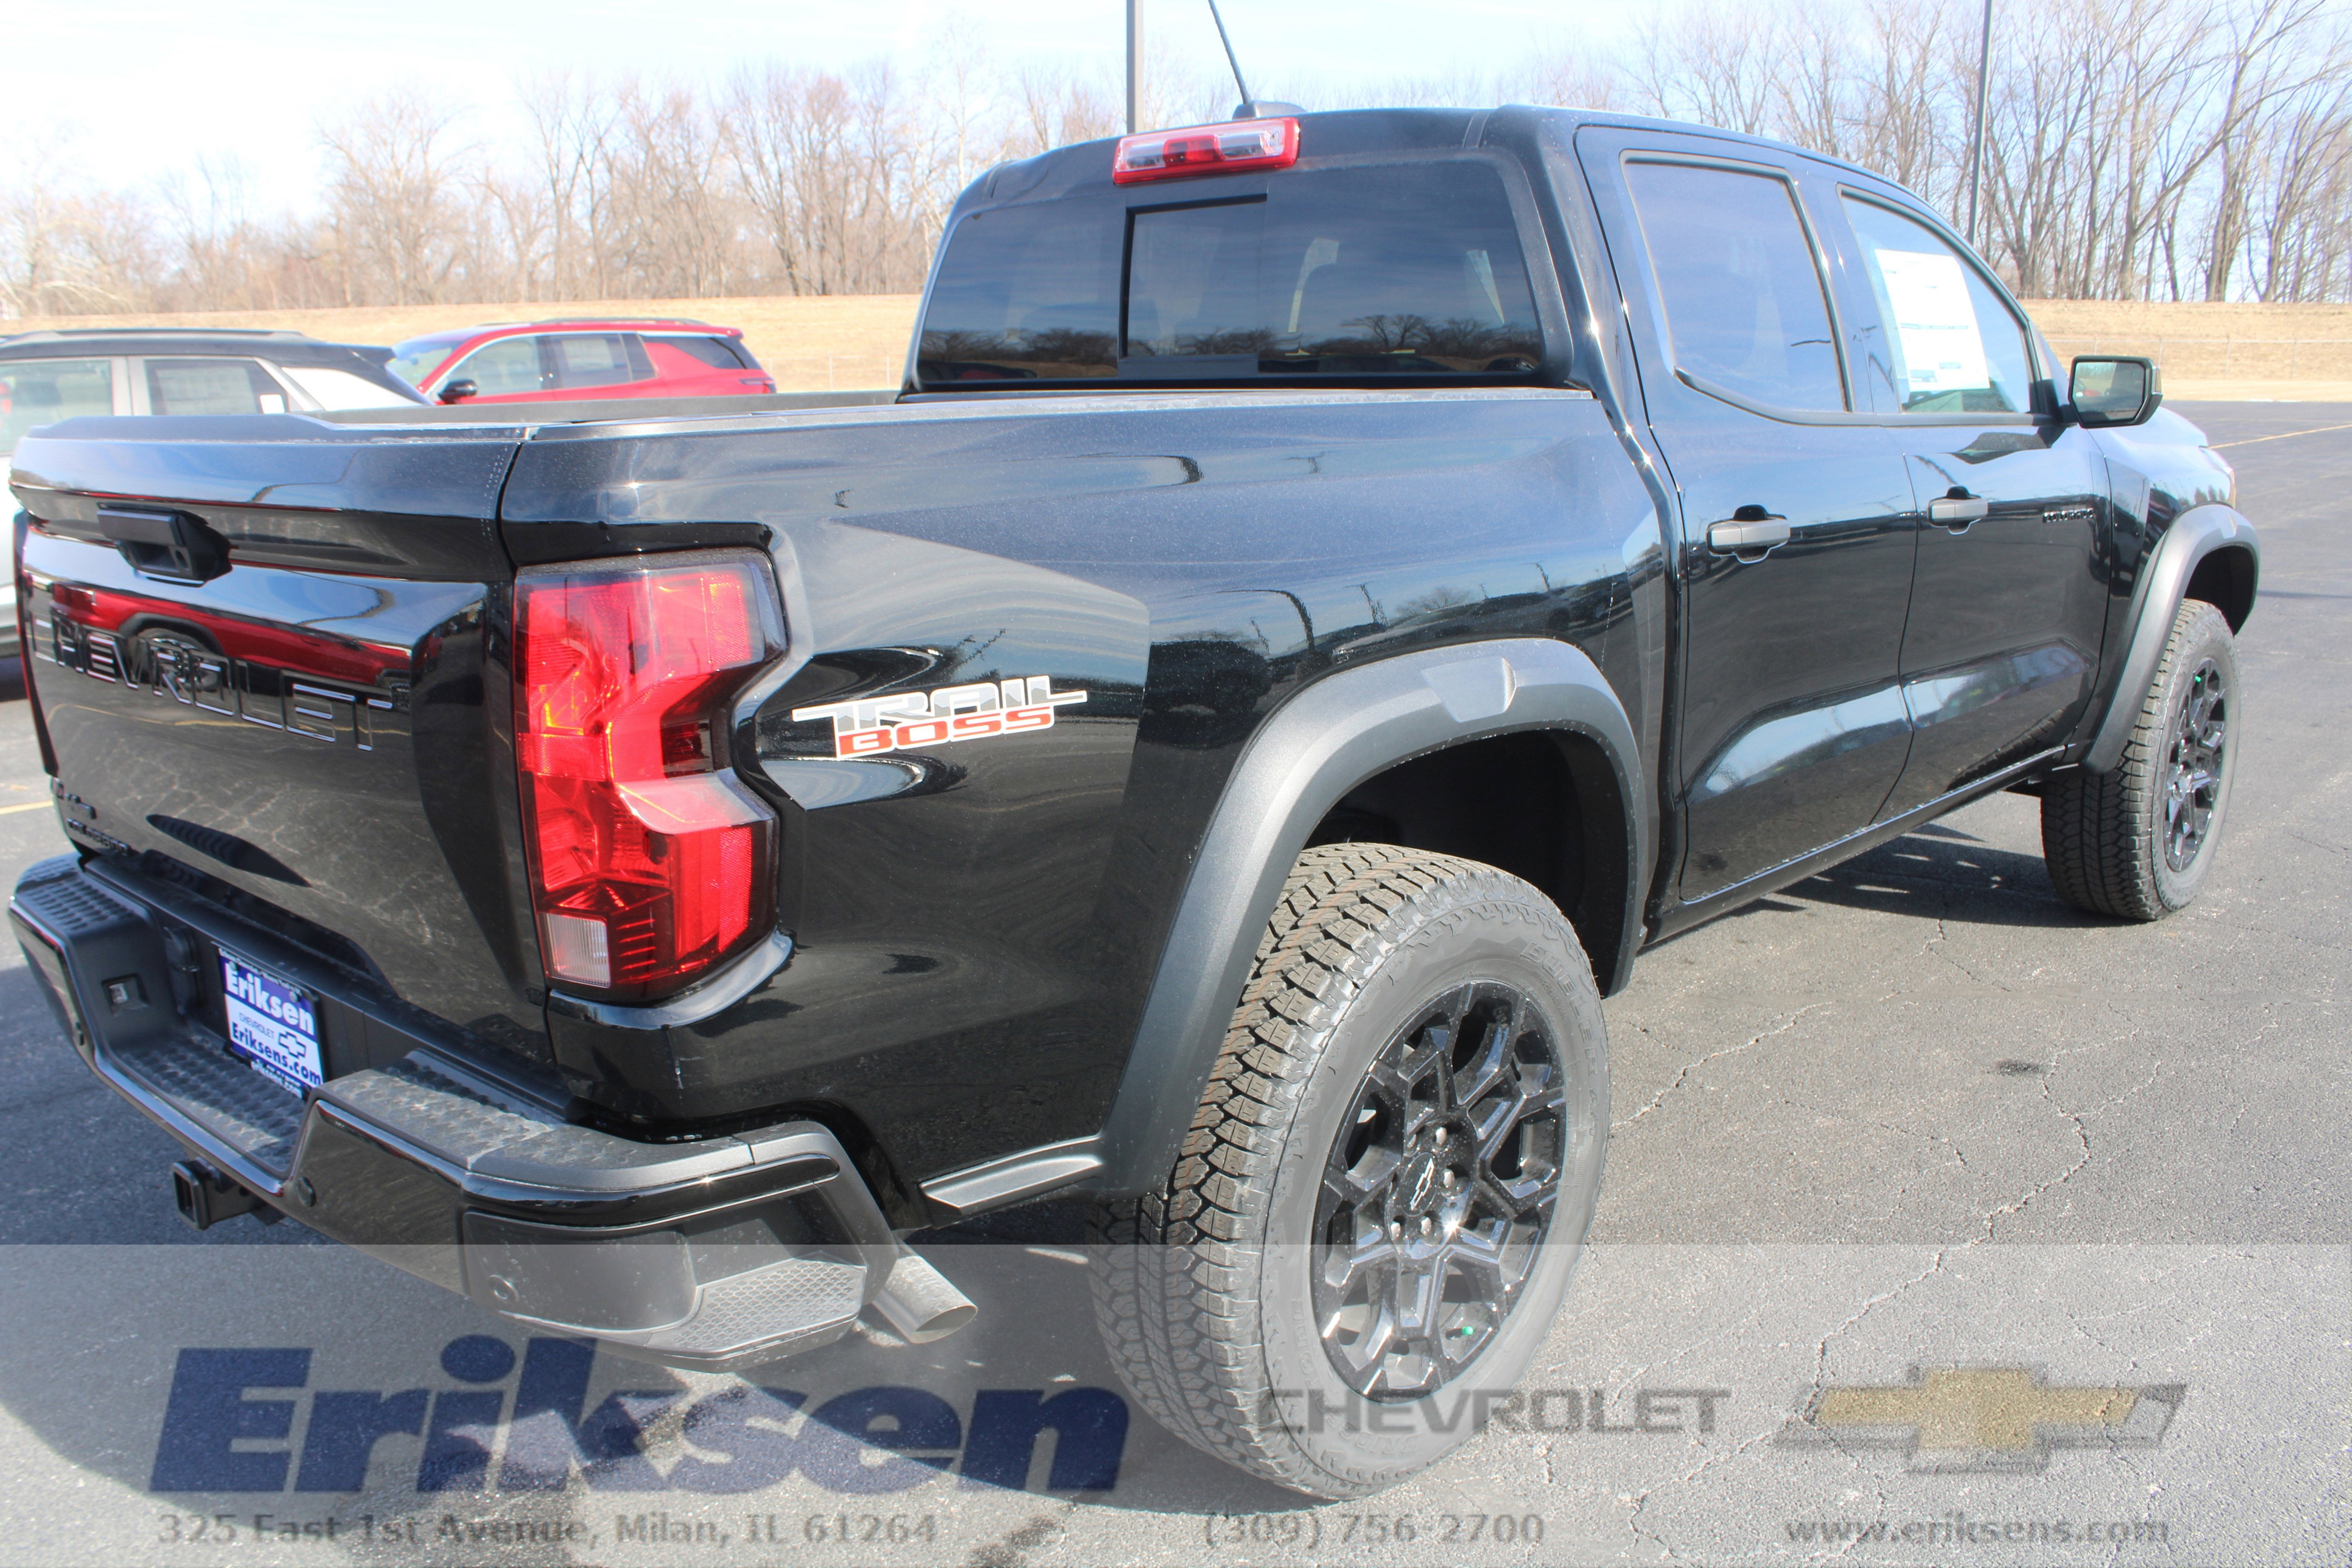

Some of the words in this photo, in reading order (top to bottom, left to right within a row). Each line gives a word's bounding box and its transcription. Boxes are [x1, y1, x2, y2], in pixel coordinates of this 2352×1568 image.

[29, 611, 392, 751] CHEVROLET
[791, 675, 1087, 732] TRAIL
[838, 706, 1053, 758] BOSS
[224, 962, 315, 1036] Eriksen
[1520, 940, 1597, 1077] DUELER
[232, 1022, 322, 1085] Eriksens.com
